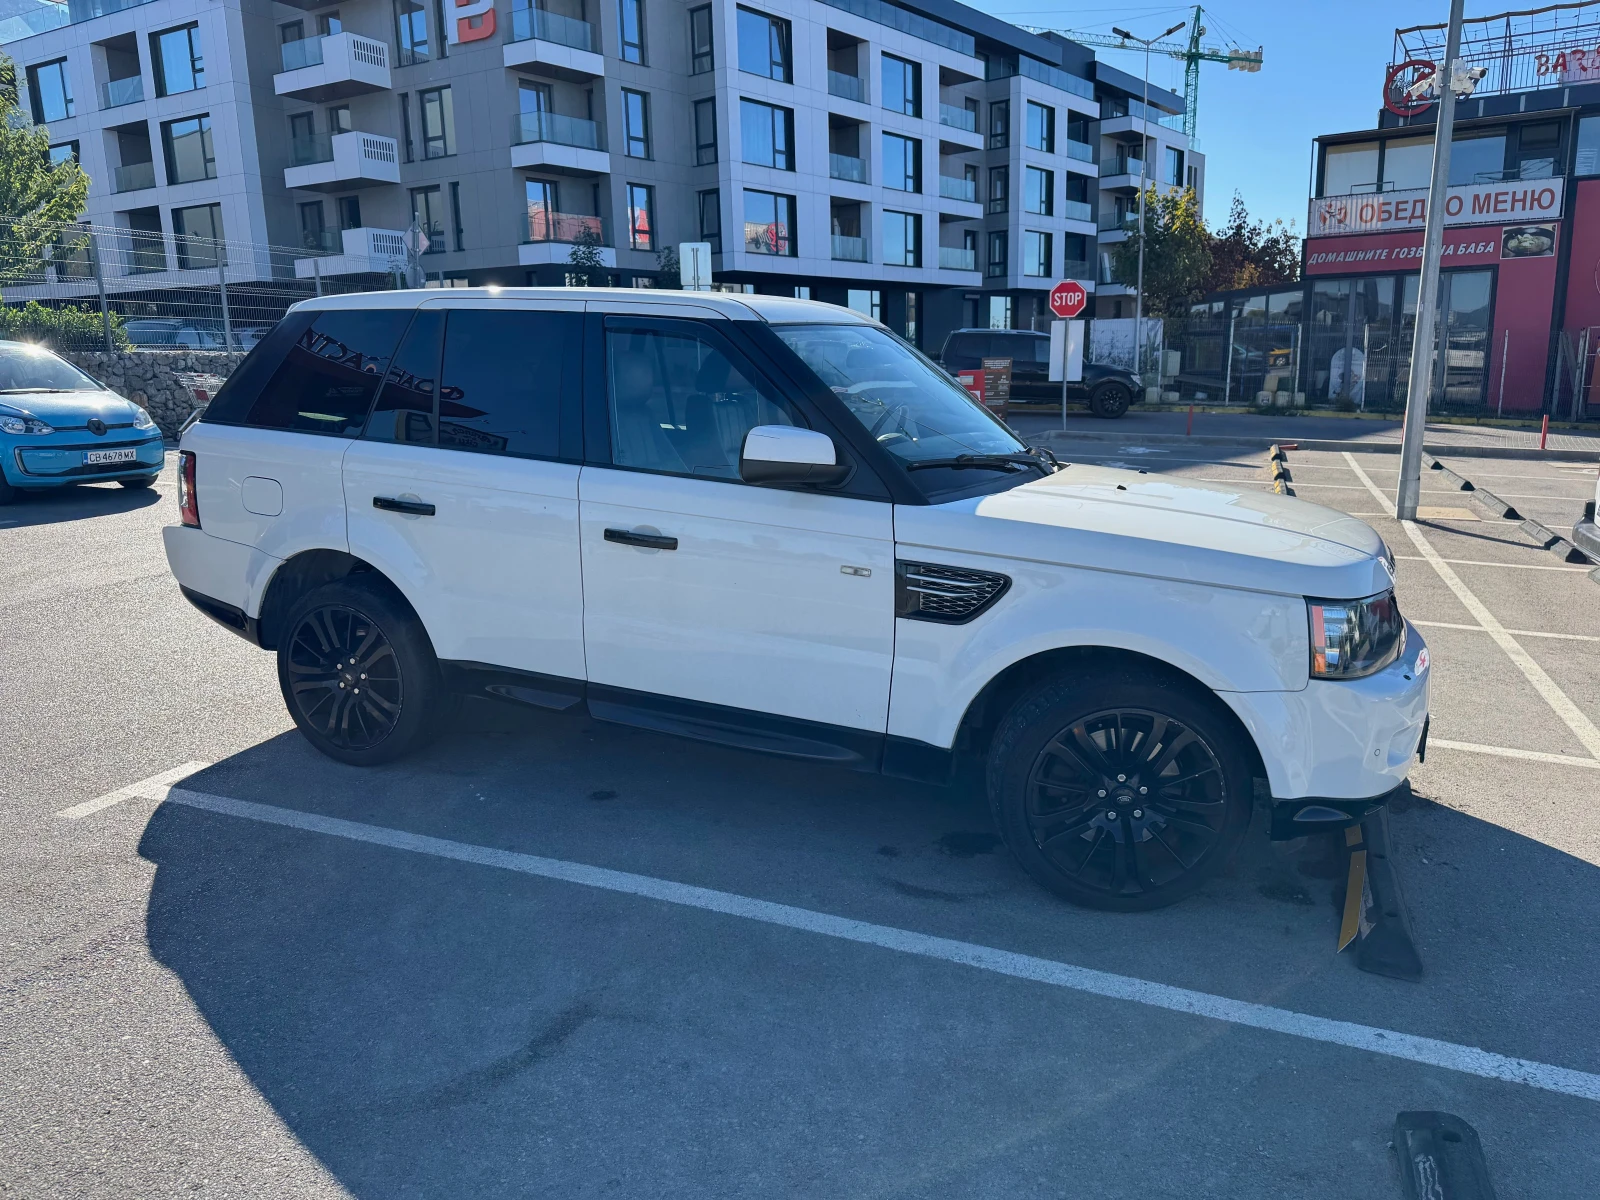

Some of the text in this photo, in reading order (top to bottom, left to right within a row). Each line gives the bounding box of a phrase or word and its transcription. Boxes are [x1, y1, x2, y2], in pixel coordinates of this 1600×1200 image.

[1359, 188, 1557, 225] ОБЕДО МЕНЮ
[1307, 248, 1390, 266] ДОМАШНИТЕ
[1392, 246, 1425, 260] ГОЗБ
[1457, 241, 1495, 255] БАБА
[1053, 292, 1082, 306] STOP
[102, 451, 122, 461] 4678
